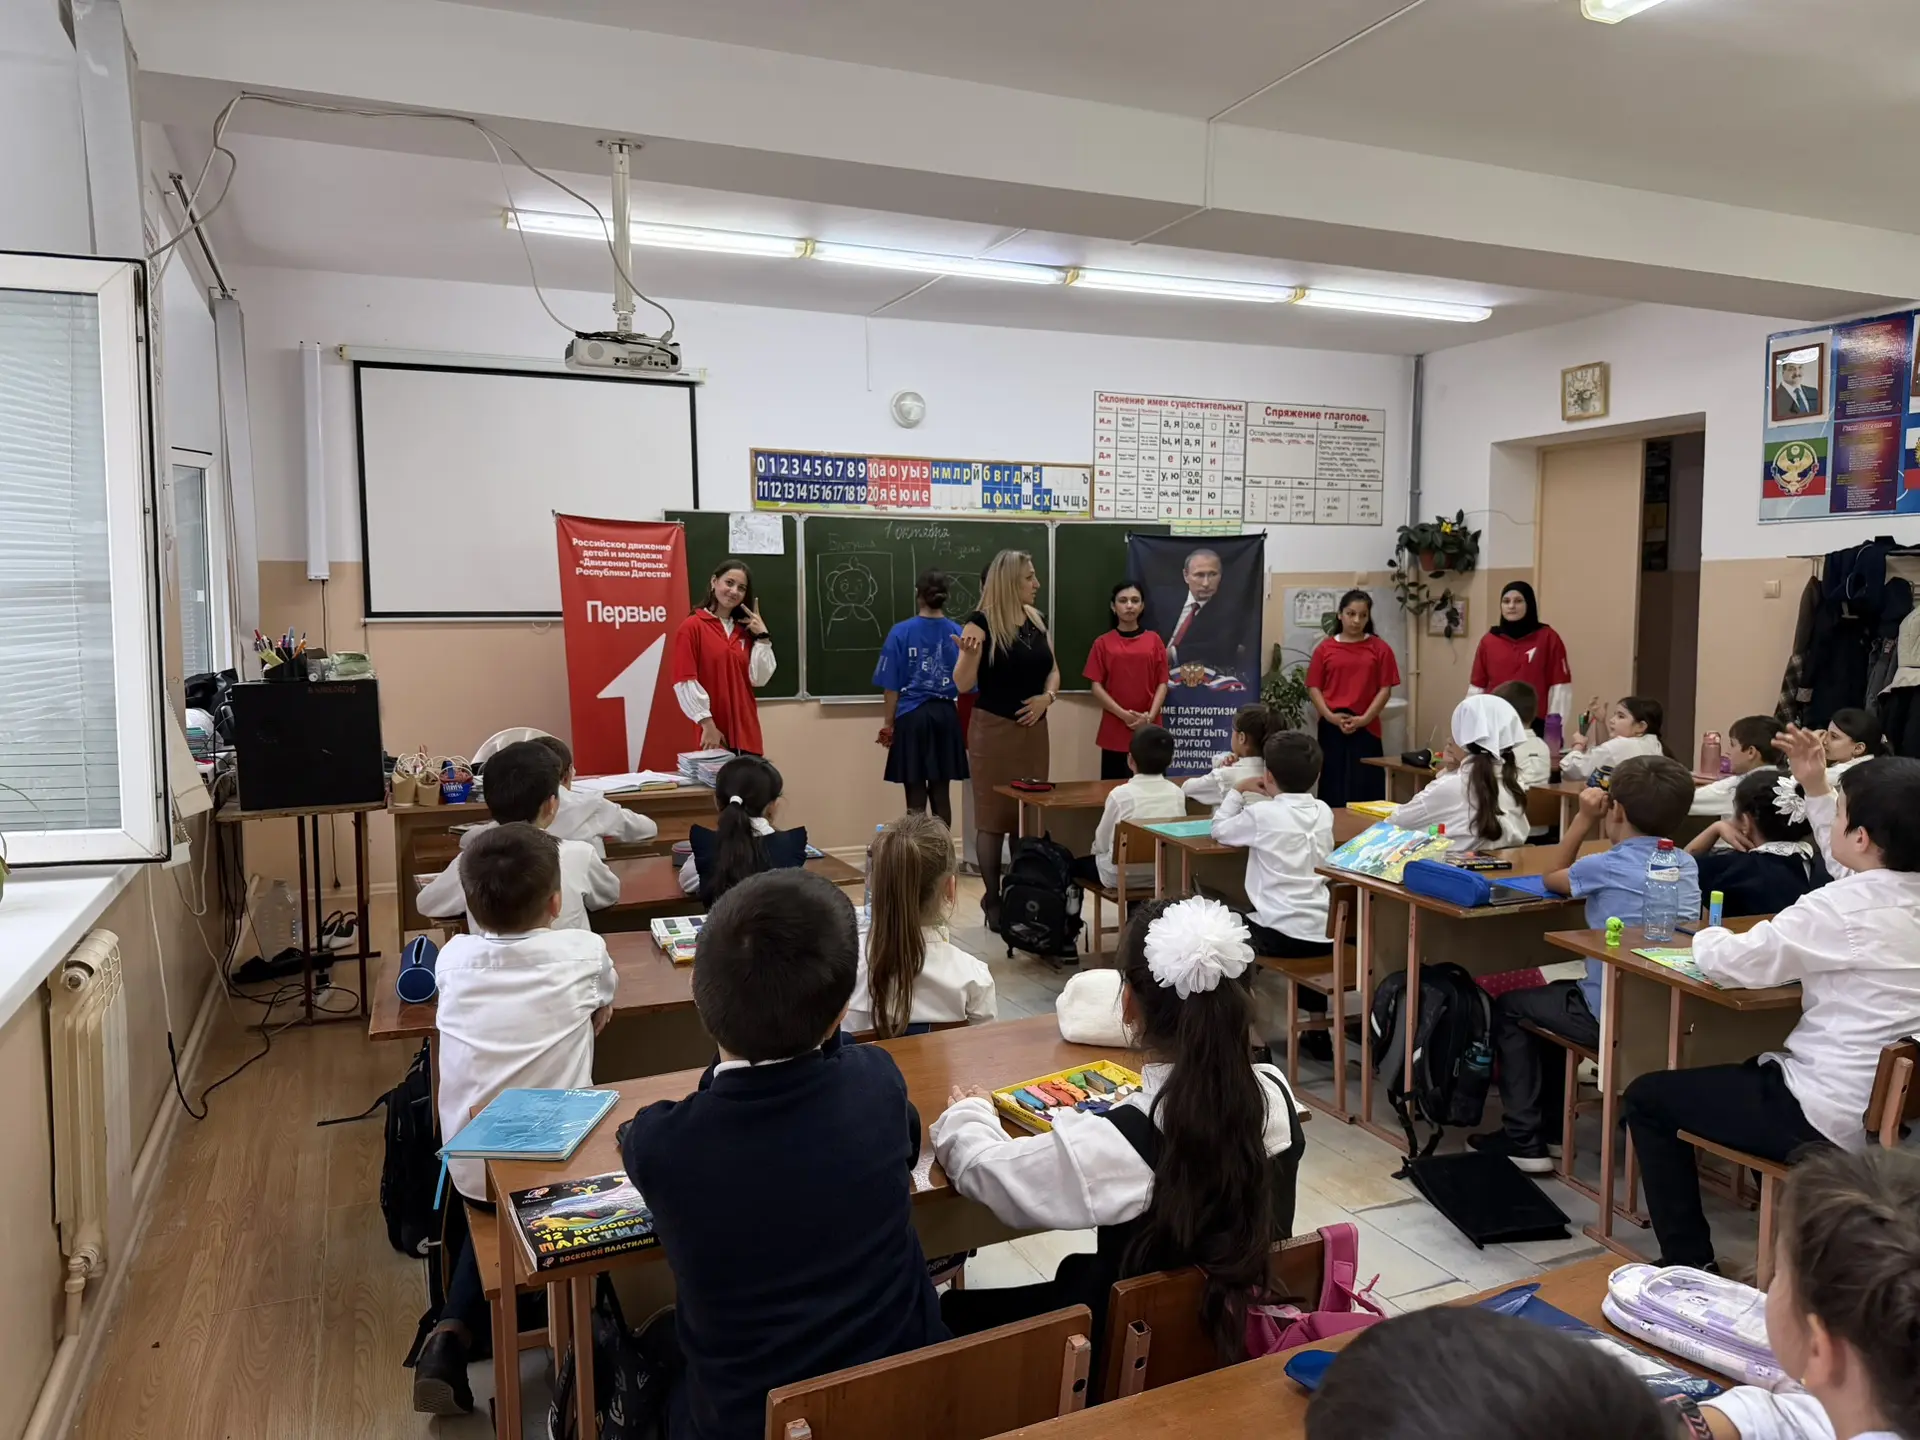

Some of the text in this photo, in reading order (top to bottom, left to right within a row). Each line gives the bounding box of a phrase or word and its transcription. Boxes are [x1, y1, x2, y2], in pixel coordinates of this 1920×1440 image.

[1098, 394, 1144, 405] Склонение
[1171, 402, 1243, 411] существительных
[1265, 406, 1369, 422] Спряжение глаголов.
[895, 522, 950, 550] октября
[572, 538, 671, 551] Российское движение
[580, 558, 629, 567] «Движение
[576, 567, 671, 578] Республики Дагестан
[587, 601, 666, 629] Первые
[909, 647, 917, 657] П
[1160, 706, 1237, 715] МЕ ПАТРИОТИЗМ
[1170, 717, 1213, 726] У РОССИИ
[1203, 729, 1228, 737] БЫТЬ
[1173, 750, 1222, 758] ДИНЯЮЩ
[543, 1216, 643, 1241] 12 ВОСКОВОЙ
[560, 1237, 654, 1263] ВОСКОВОЙ ПЛАСТИЛИН
